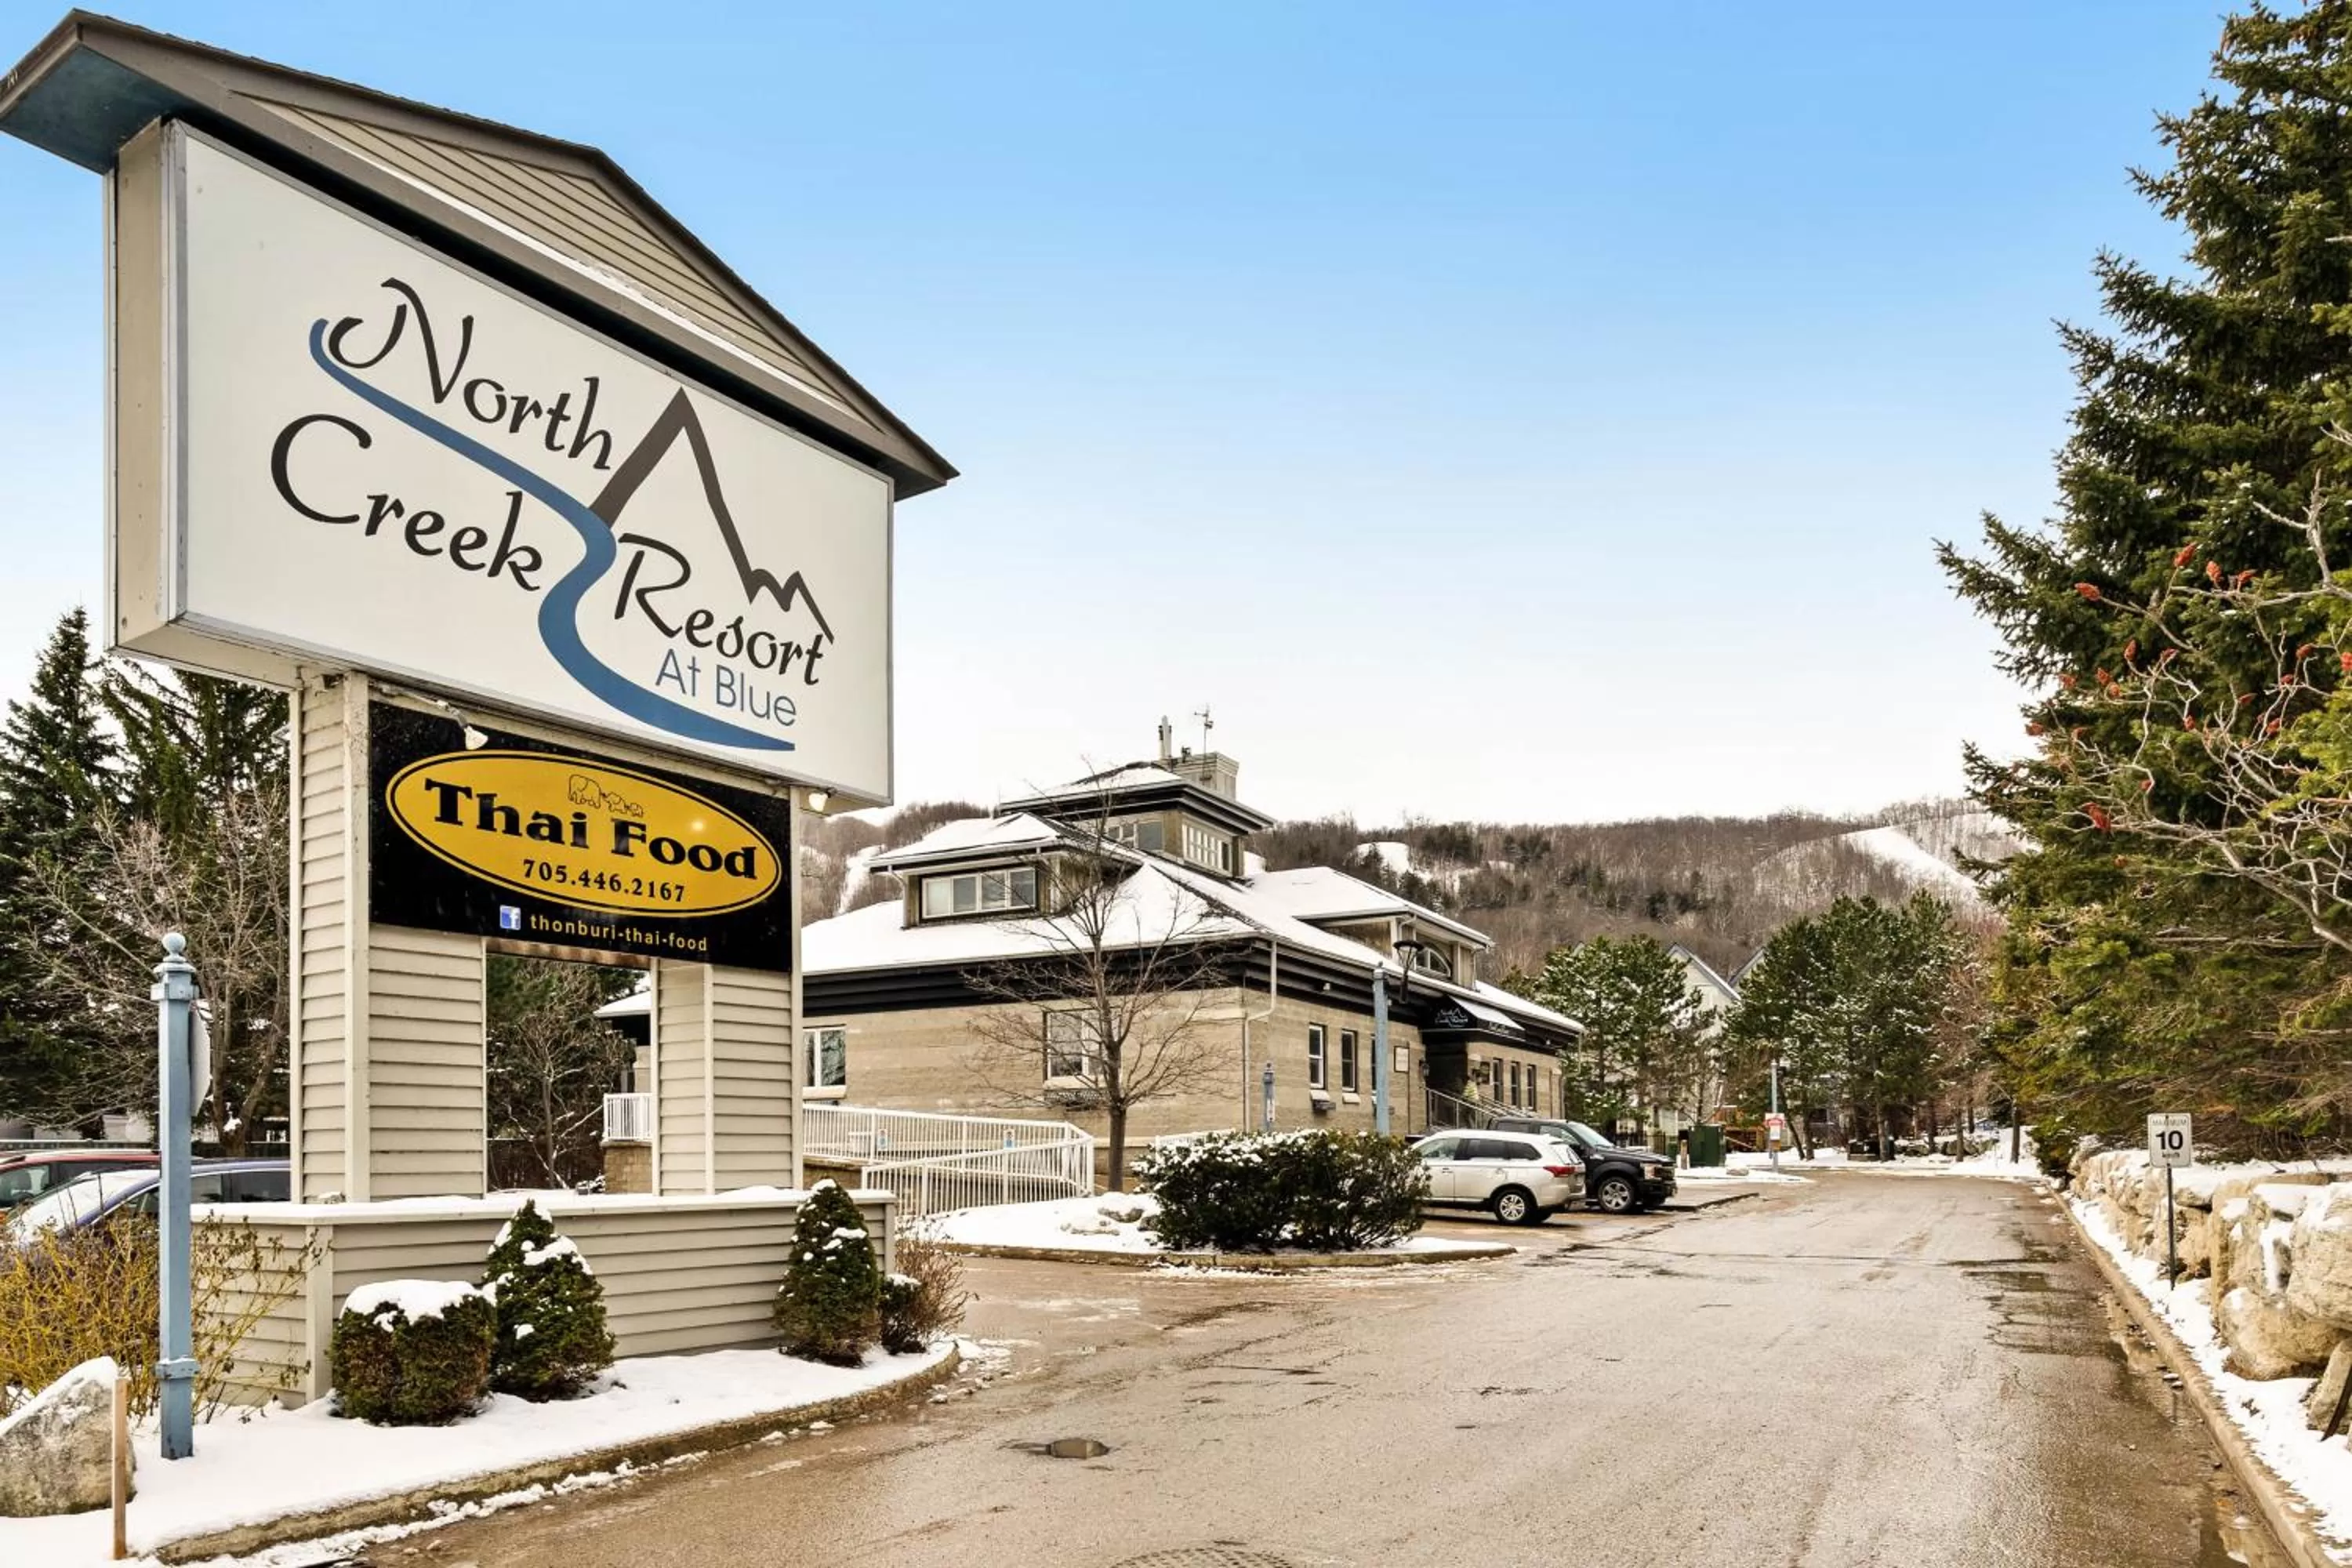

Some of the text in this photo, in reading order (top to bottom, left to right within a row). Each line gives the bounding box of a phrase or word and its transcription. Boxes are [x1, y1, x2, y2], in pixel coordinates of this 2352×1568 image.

[328, 278, 613, 470] North
[270, 414, 824, 685] Creek Resort
[655, 648, 797, 727] At Blue
[424, 778, 758, 880] Thai Food
[523, 859, 685, 902] 705.446.2167
[530, 913, 707, 951] thonburi-thai-food
[2155, 1130, 2183, 1150] 10
